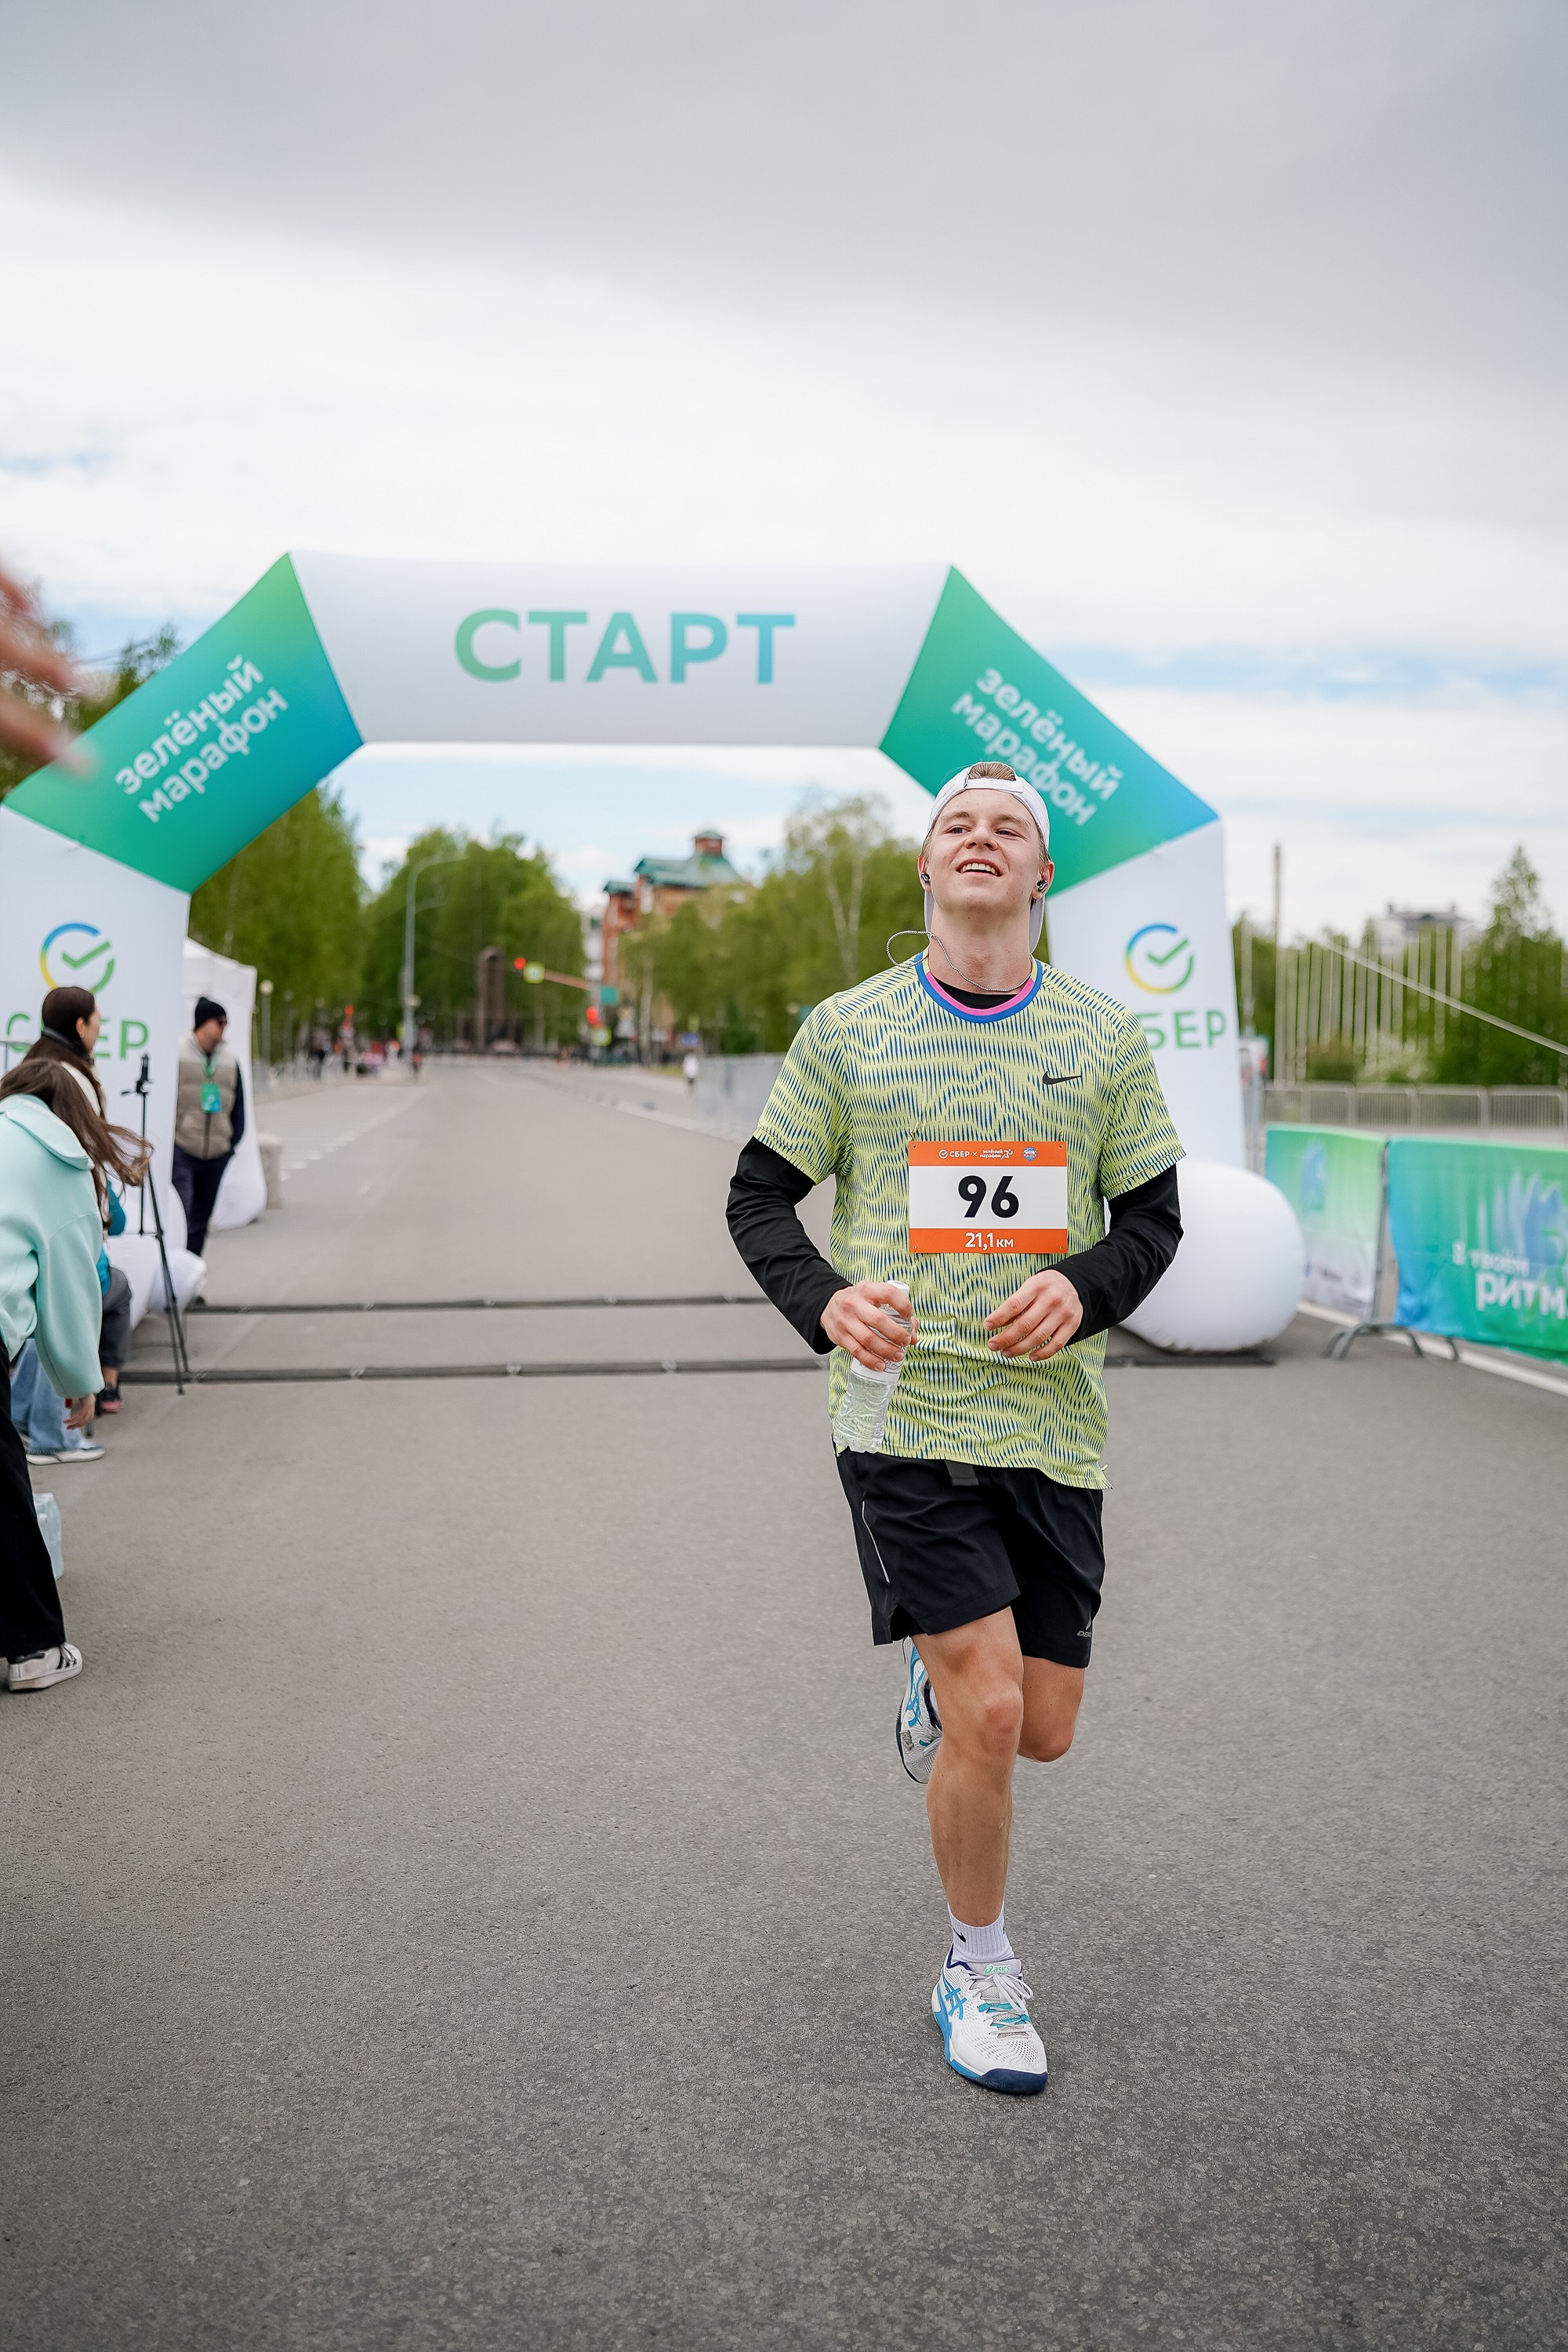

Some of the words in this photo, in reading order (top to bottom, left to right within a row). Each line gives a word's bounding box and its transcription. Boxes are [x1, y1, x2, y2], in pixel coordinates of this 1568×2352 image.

[455, 608, 797, 684] СТАРТ
[115, 654, 264, 795] зелёный
[138, 688, 289, 823] марафон
[952, 691, 1097, 826] марафон
[975, 668, 1123, 801] зелёный
[1136, 1010, 1227, 1051] БЕР
[958, 1175, 1019, 1218] 96
[1475, 1270, 1567, 1320] ритм
